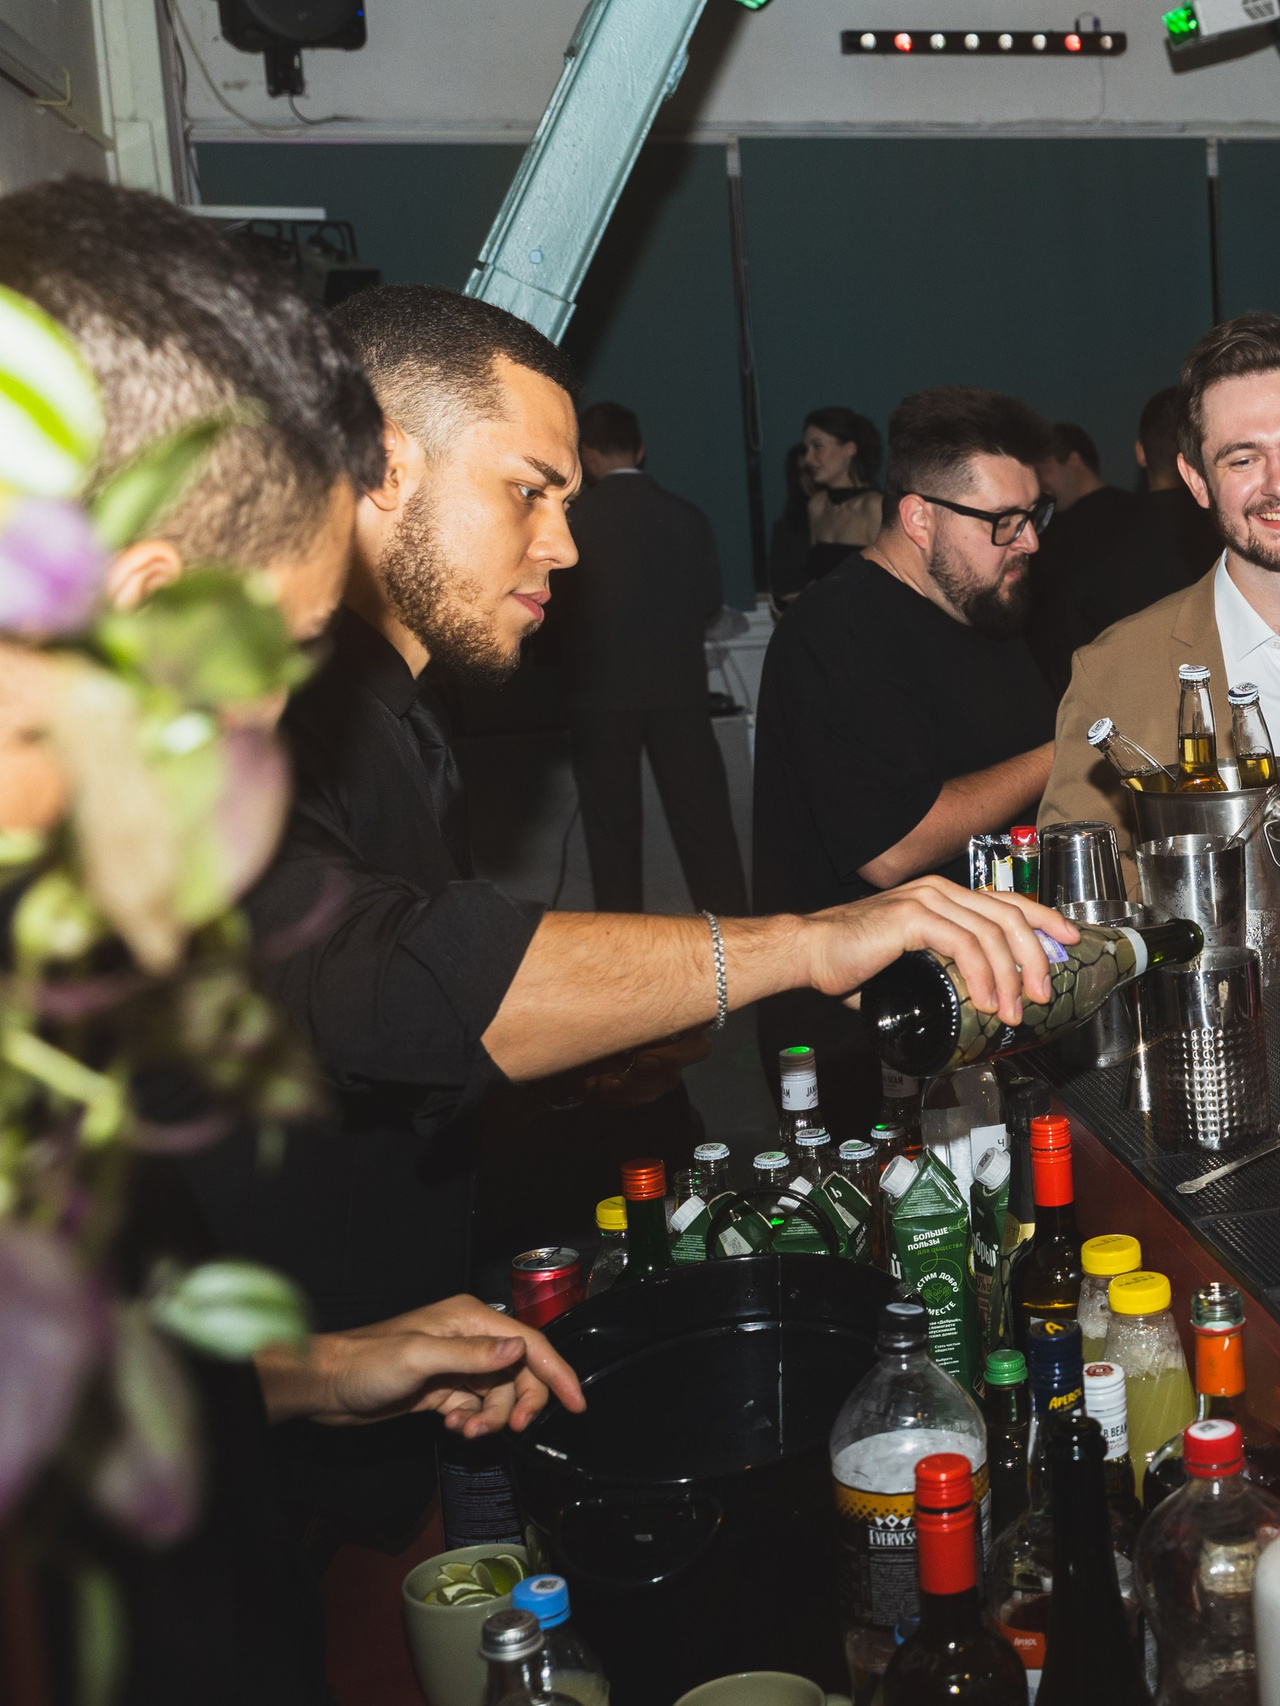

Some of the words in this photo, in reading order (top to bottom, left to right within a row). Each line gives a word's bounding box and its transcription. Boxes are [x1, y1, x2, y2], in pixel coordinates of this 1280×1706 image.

[913, 1226, 949, 1242] БОЛЬШЕ
[907, 1238, 941, 1251] ПОЛЬЗЫ
[917, 1247, 931, 1256] ДЛЯ
[931, 1242, 964, 1253] ОБЩЕСТВА
[915, 1272, 938, 1293] АСТИМ
[938, 1272, 959, 1293] ДОБРО
[925, 1300, 957, 1316] МЕСТЕ
[1049, 1387, 1082, 1410] APEROL
